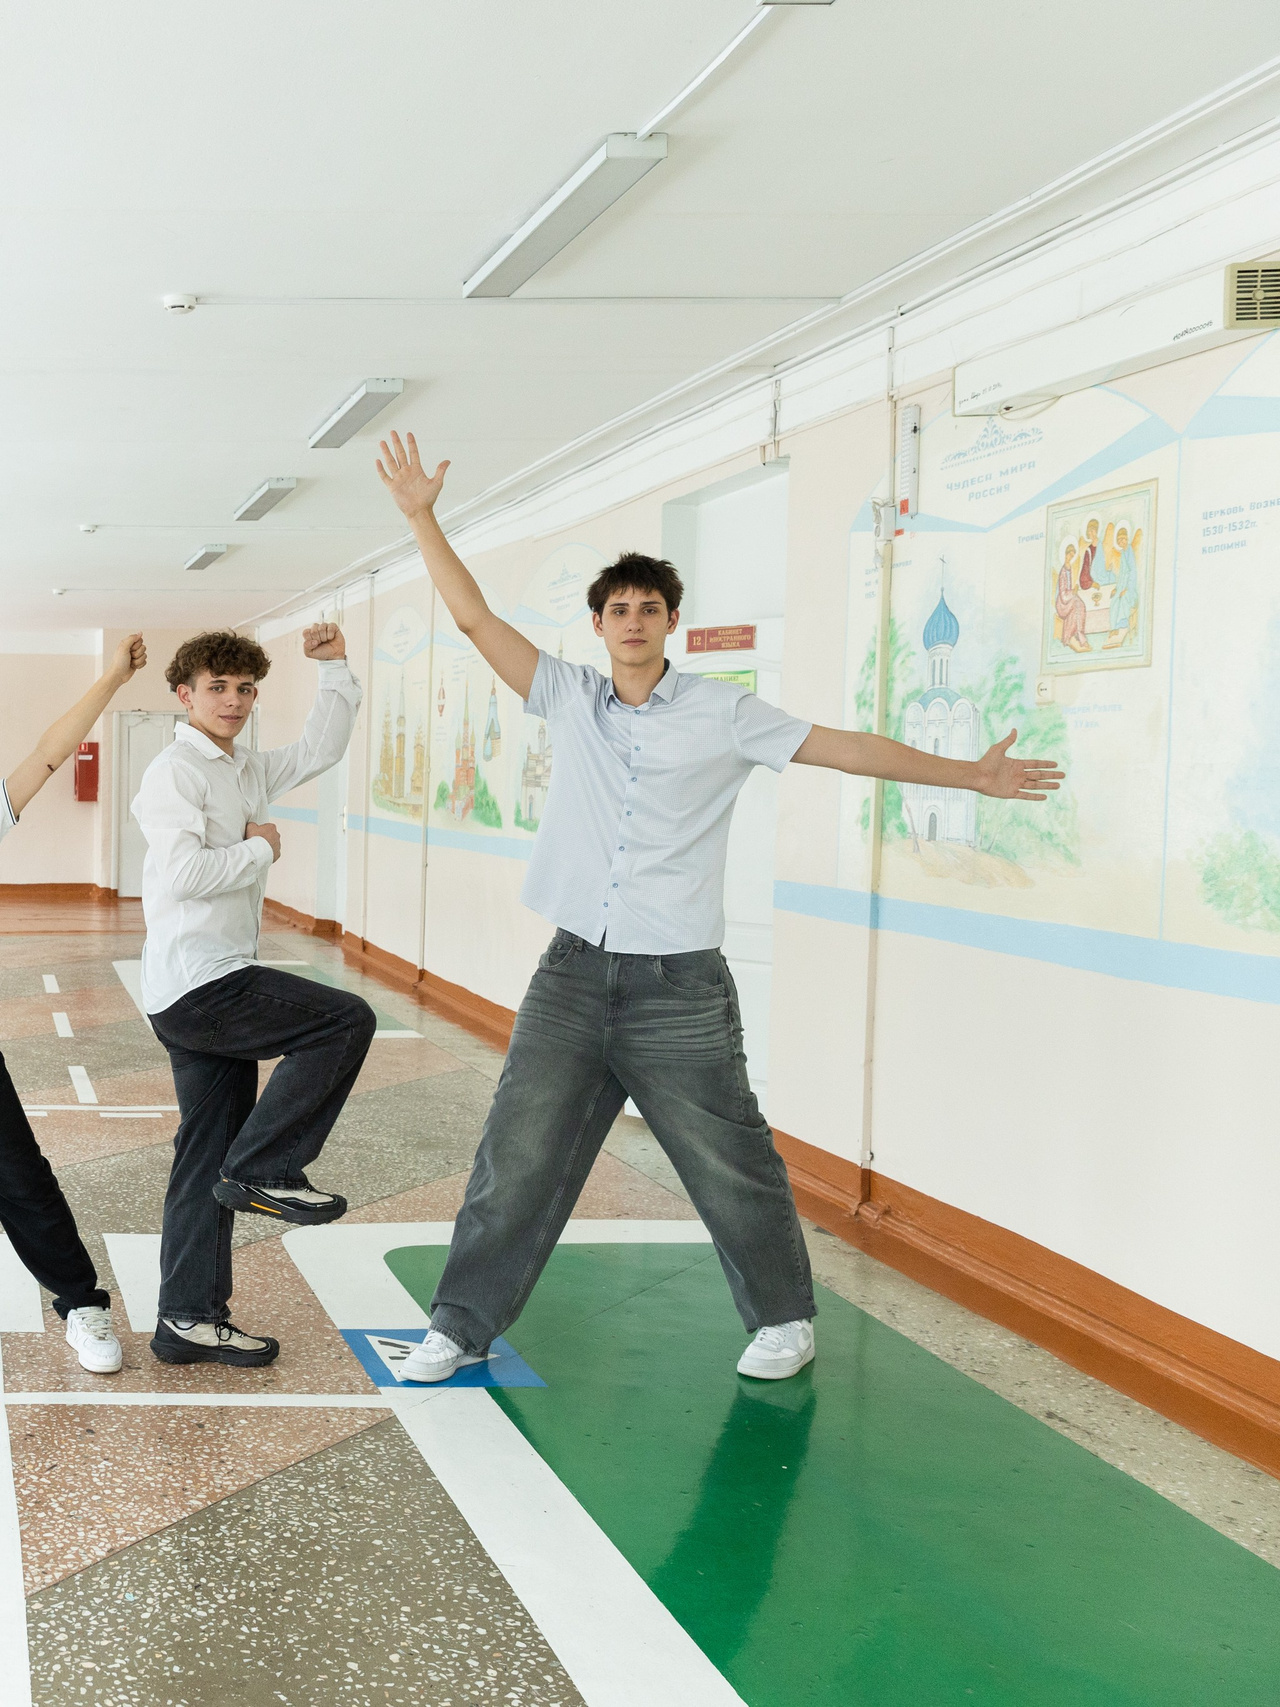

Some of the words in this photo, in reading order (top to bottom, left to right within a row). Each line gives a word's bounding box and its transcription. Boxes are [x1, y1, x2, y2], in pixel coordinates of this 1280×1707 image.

[946, 473, 992, 491] ЧУДЕСА
[999, 461, 1036, 477] МИРА
[968, 483, 1010, 502] РОССИЯ
[1202, 505, 1245, 520] ЦЕРКОВЬ
[1201, 539, 1247, 555] КОЛОМНА
[693, 636, 702, 646] 12
[709, 635, 751, 643] ИНОСТРАННОГО
